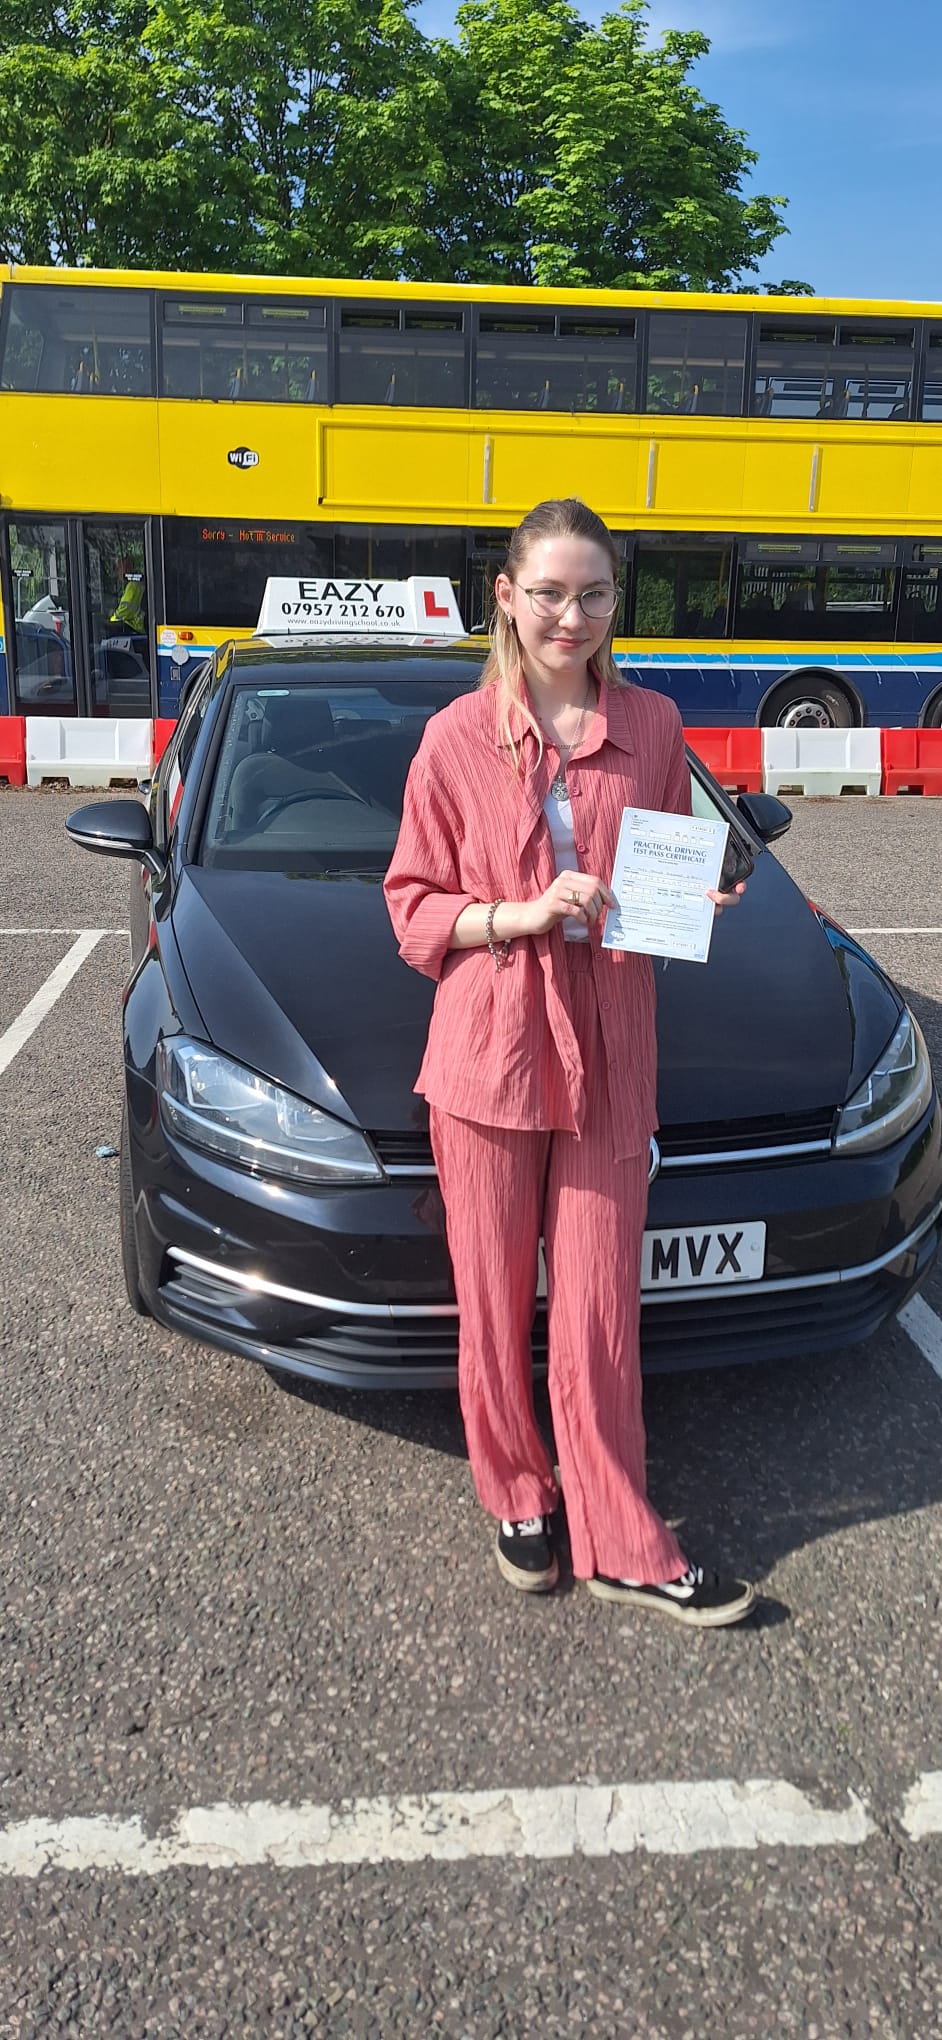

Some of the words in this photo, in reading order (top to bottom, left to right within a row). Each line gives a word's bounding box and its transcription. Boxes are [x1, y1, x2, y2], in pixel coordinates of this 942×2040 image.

[202, 528, 225, 540] Sorry
[266, 530, 295, 543] Service
[299, 581, 384, 602] EAZY
[281, 602, 332, 616] 07957
[339, 604, 370, 617] 212
[375, 605, 405, 618] 670
[423, 591, 450, 617] L
[287, 617, 401, 627] www.eazydrivingschool.co.uk
[633, 840, 672, 852] PRACTICAL
[674, 846, 707, 857] DRIVING
[665, 852, 706, 864] CERTIFICATE
[651, 1232, 744, 1280] MVX
